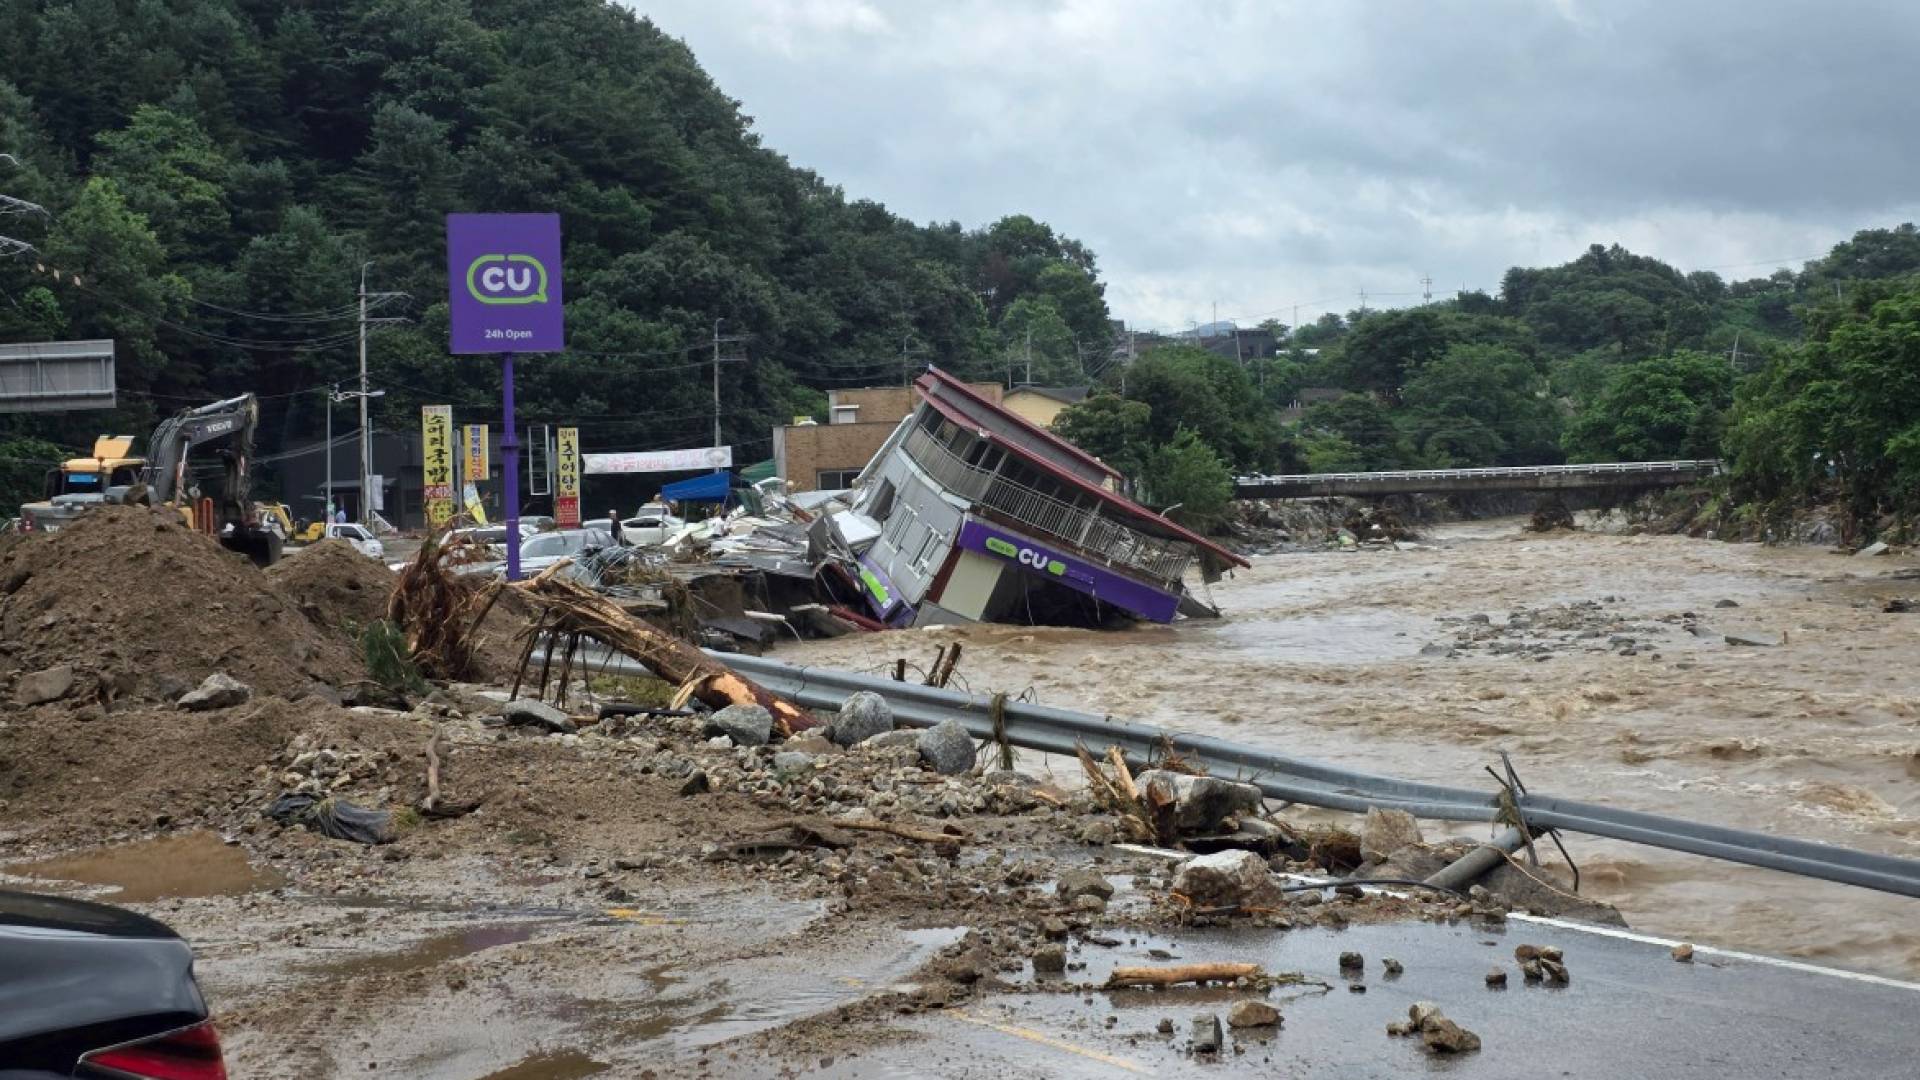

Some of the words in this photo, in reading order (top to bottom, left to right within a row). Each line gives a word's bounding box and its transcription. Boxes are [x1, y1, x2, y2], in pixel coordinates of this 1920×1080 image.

[482, 266, 532, 293] CU
[485, 329, 504, 339] 24h
[505, 329, 533, 341] Open
[561, 440, 577, 491] 추어탕
[1018, 548, 1049, 570] CU
